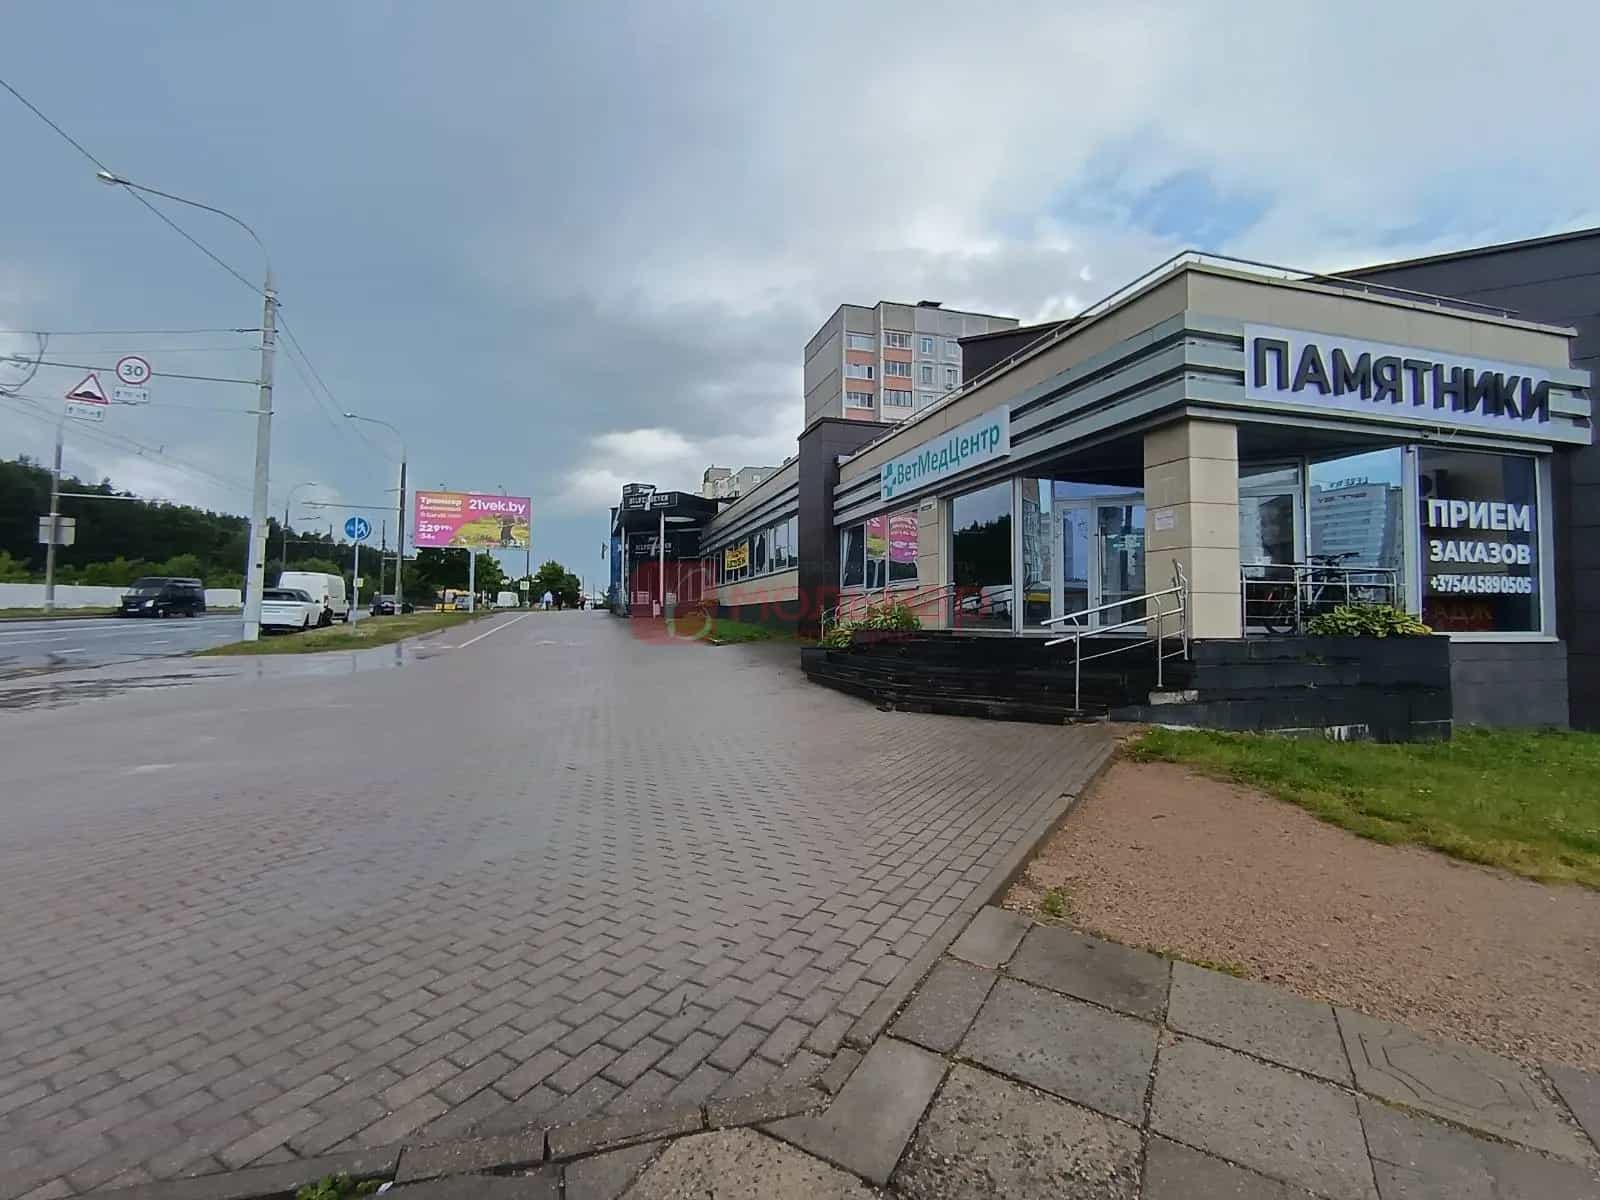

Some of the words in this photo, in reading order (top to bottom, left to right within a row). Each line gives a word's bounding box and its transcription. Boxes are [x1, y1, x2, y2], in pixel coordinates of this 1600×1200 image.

[123, 364, 144, 377] 30
[1254, 337, 1551, 423] ПАМЯТНИКИ
[896, 424, 1000, 484] ВетМедЦентр
[468, 499, 526, 514] 21vek.by
[1428, 499, 1531, 532] ПРИЕМ
[1430, 539, 1531, 564] ЗАКАЗОВ
[1430, 574, 1532, 593] +375445890505
